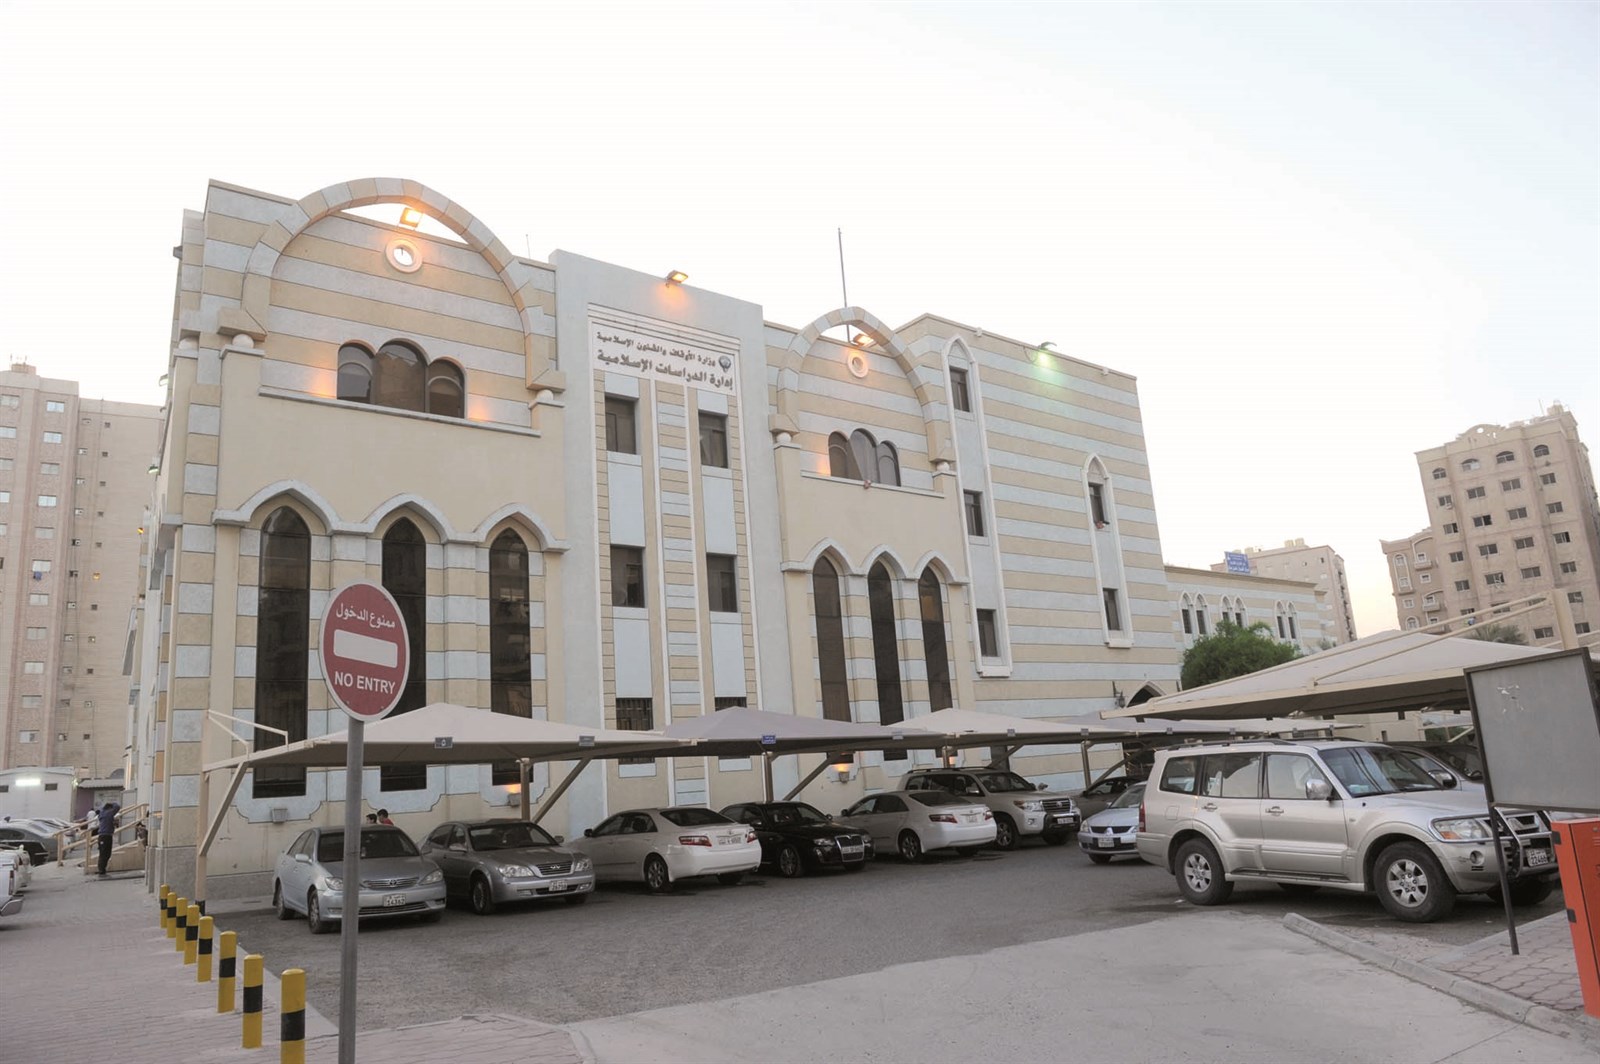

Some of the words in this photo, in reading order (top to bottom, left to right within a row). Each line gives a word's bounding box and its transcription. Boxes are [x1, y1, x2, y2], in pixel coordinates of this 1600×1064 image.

[597, 349, 652, 372] الإسلامية
[697, 354, 716, 367] وزارة
[655, 363, 707, 382] الدراسات
[709, 373, 733, 390] إدارة
[335, 602, 369, 621] الدخول
[369, 612, 396, 628] ممنوع
[334, 671, 354, 687] NO
[356, 675, 396, 694] ENTRY
